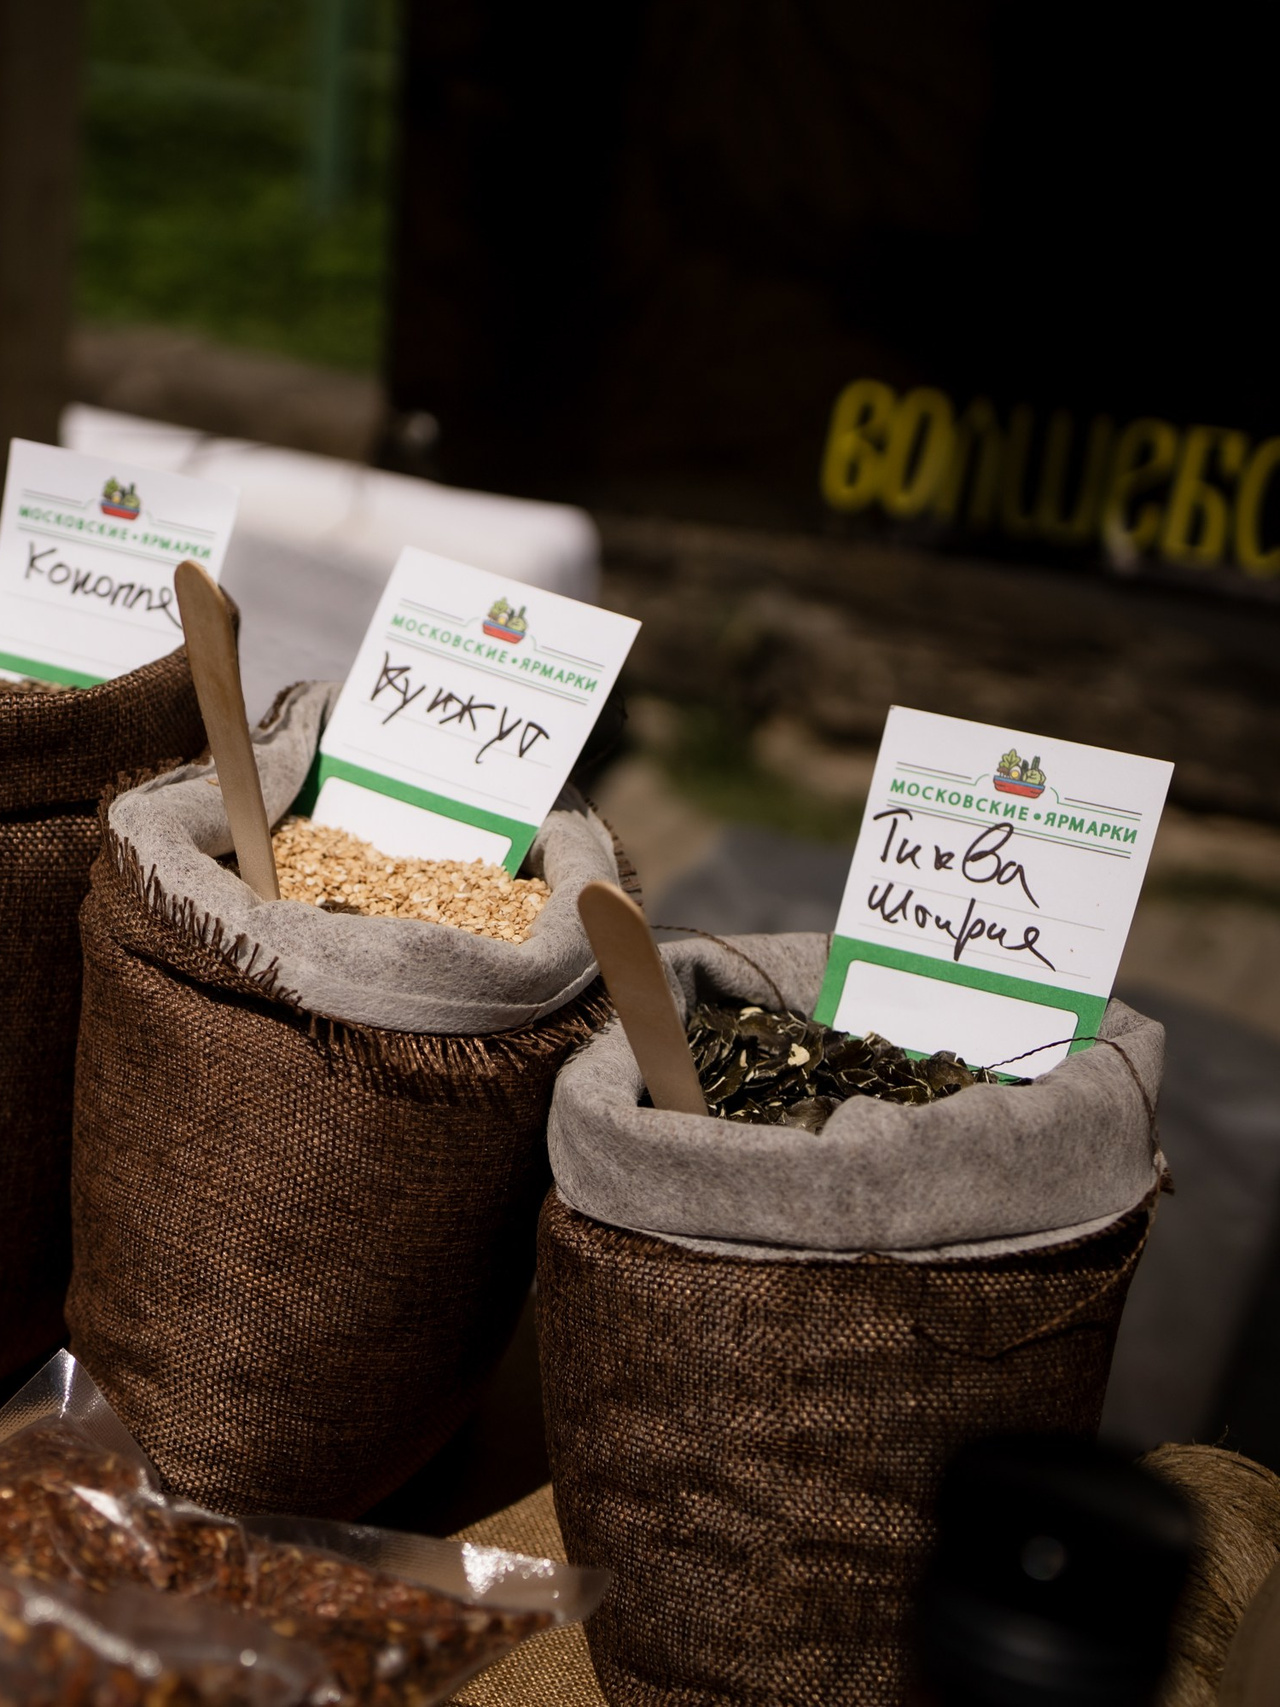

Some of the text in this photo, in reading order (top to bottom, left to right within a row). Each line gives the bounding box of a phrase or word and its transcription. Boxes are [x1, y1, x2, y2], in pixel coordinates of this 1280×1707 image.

[140, 533, 211, 560] ЯРМАРКИ
[391, 614, 598, 693] МОСКОВСКИЕ ЯРМАРКИ
[890, 778, 1139, 845] МОСКОВСКИЕ ЯРМАРКИ
